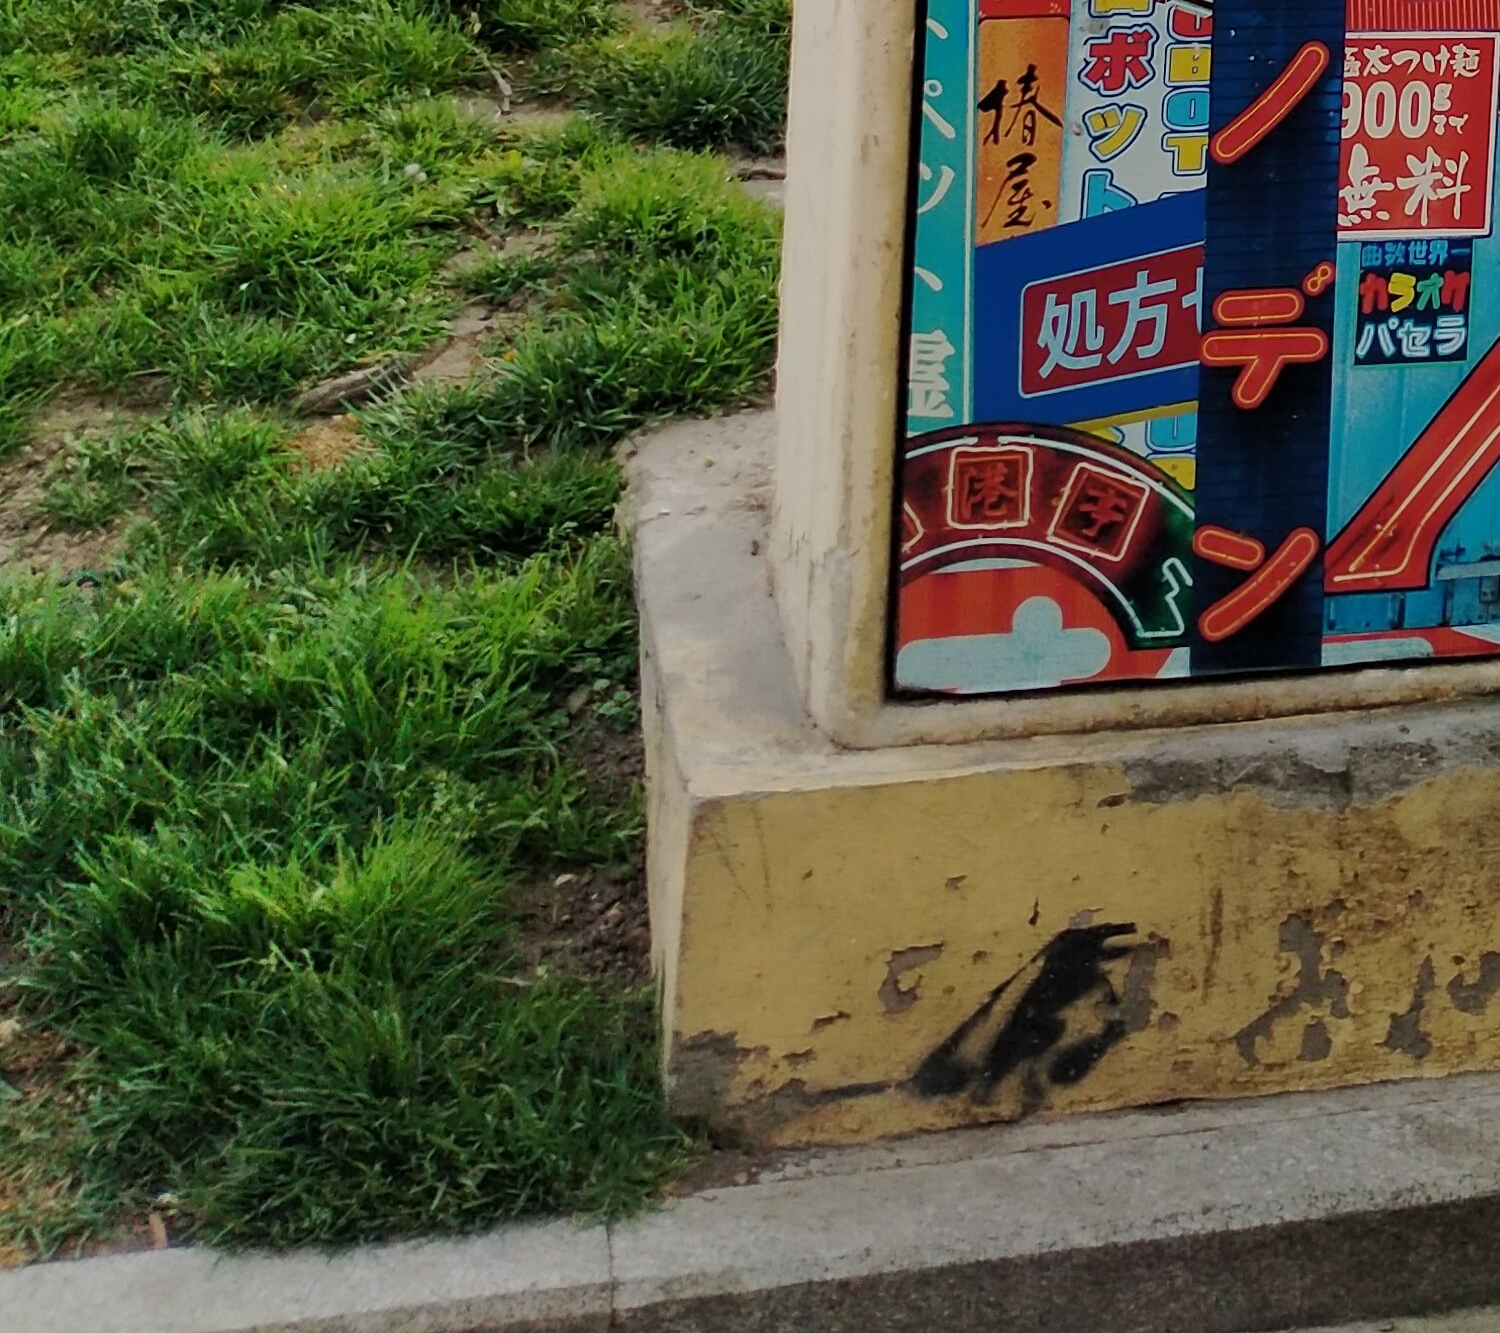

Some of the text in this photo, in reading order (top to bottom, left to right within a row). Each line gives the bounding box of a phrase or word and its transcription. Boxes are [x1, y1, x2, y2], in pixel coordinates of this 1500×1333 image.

[1338, 143, 1472, 228] 無料
[1360, 270, 1470, 315] カラオケ
[1356, 314, 1468, 361] パセラ
